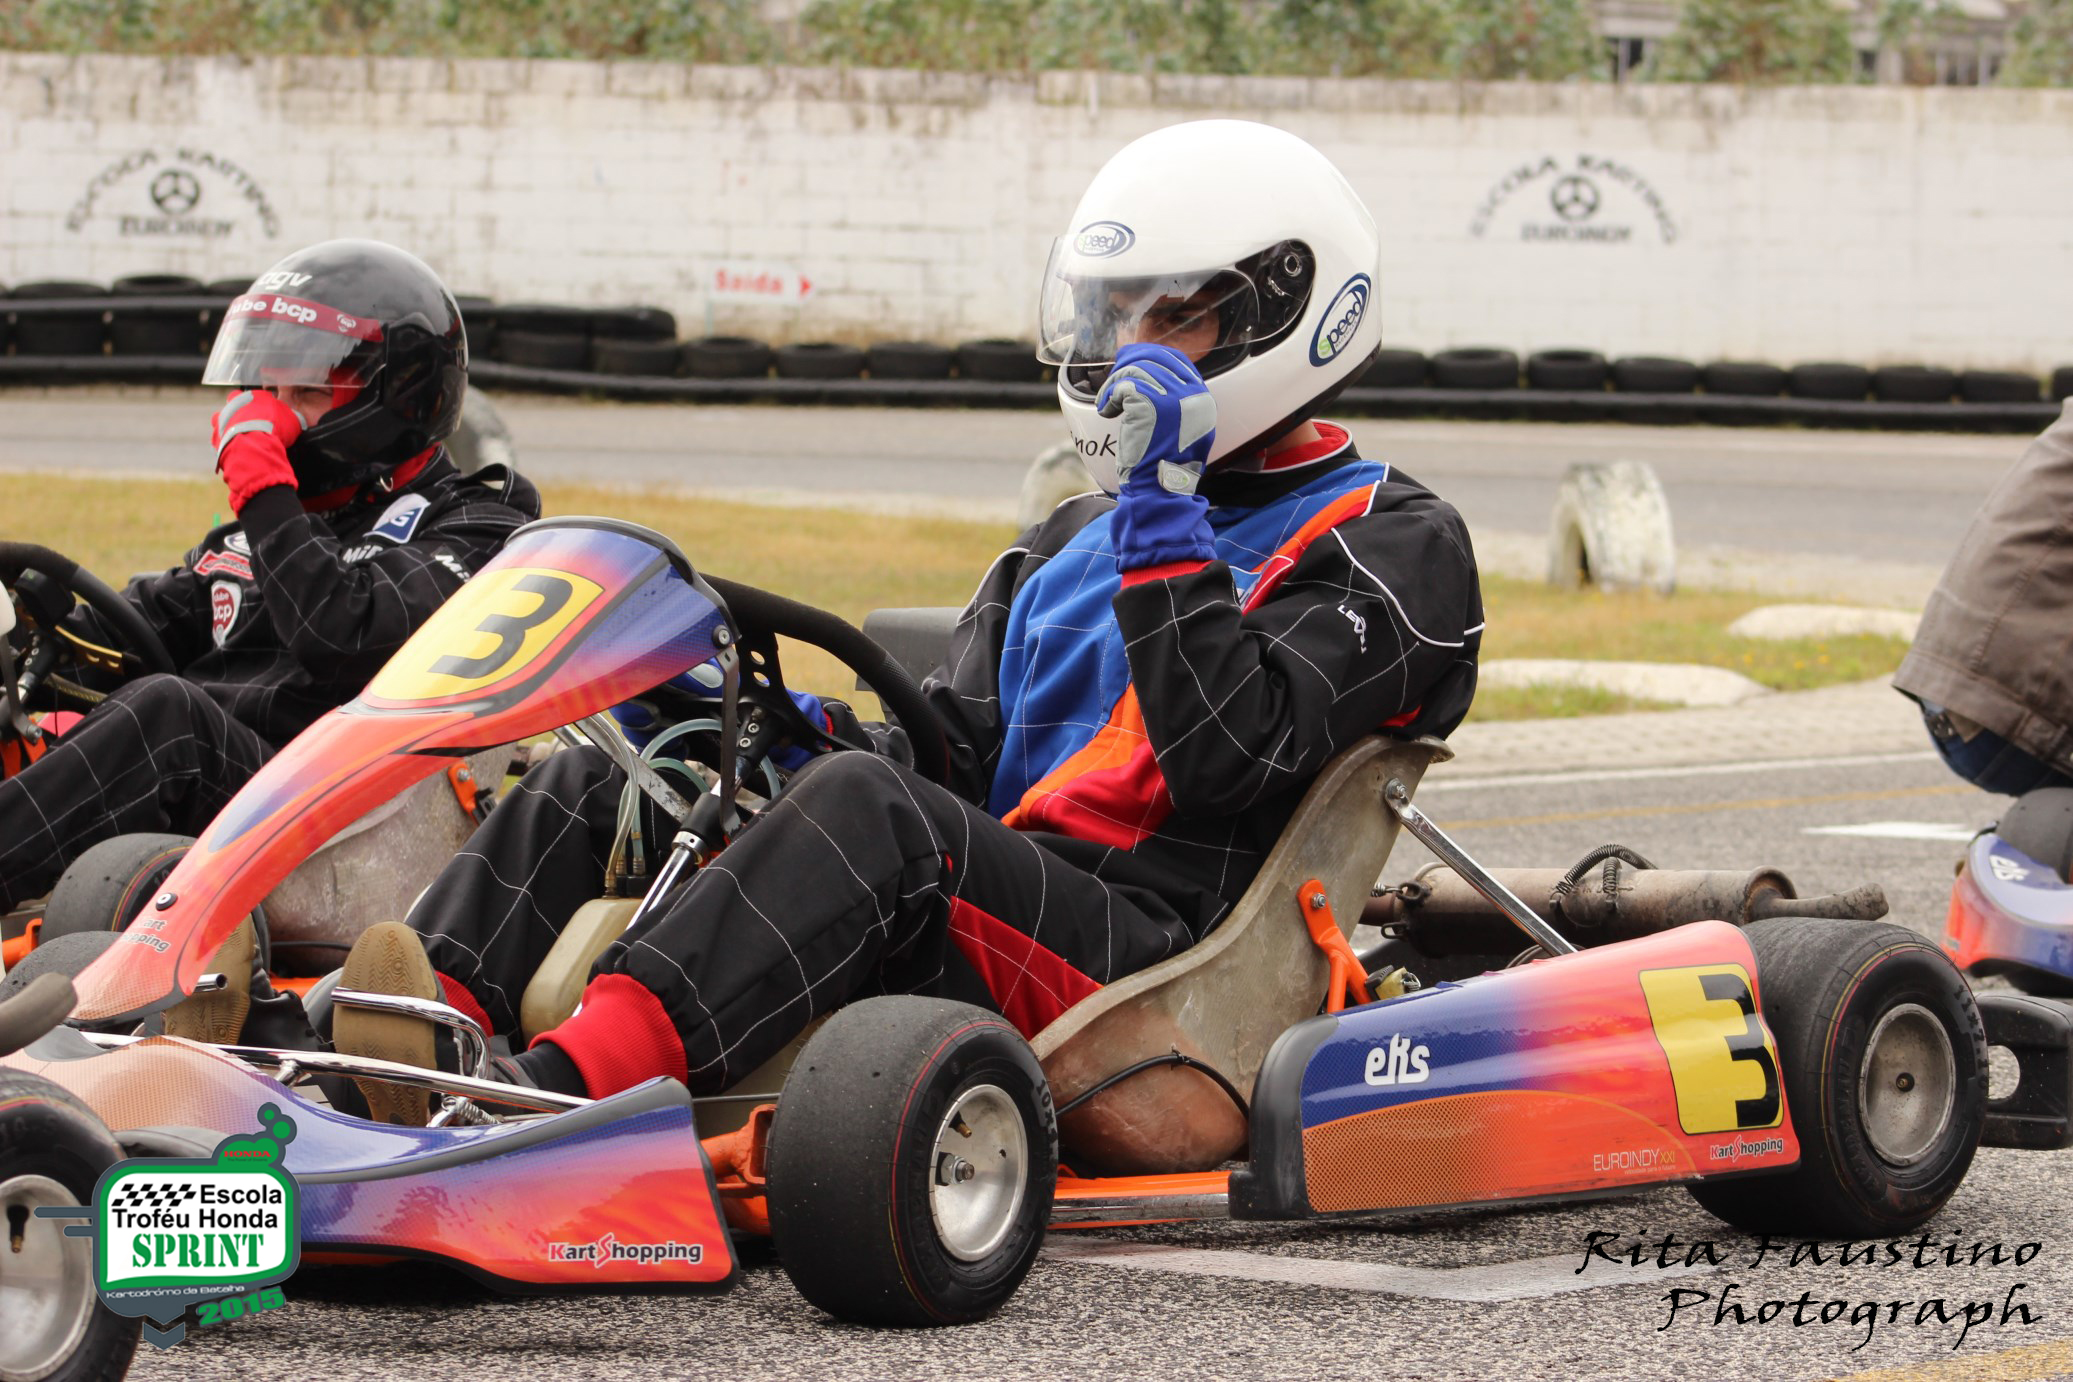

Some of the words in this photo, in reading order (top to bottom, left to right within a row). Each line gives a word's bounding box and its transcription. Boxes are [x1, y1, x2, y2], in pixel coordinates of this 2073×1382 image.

[257, 271, 312, 290] agv
[271, 297, 317, 322] bcp
[1318, 291, 1363, 356] speed
[427, 574, 573, 679] 3
[1698, 972, 1780, 1128] 3
[1593, 1149, 1660, 1172] EUROINDY
[1660, 1151, 1676, 1165] XXI
